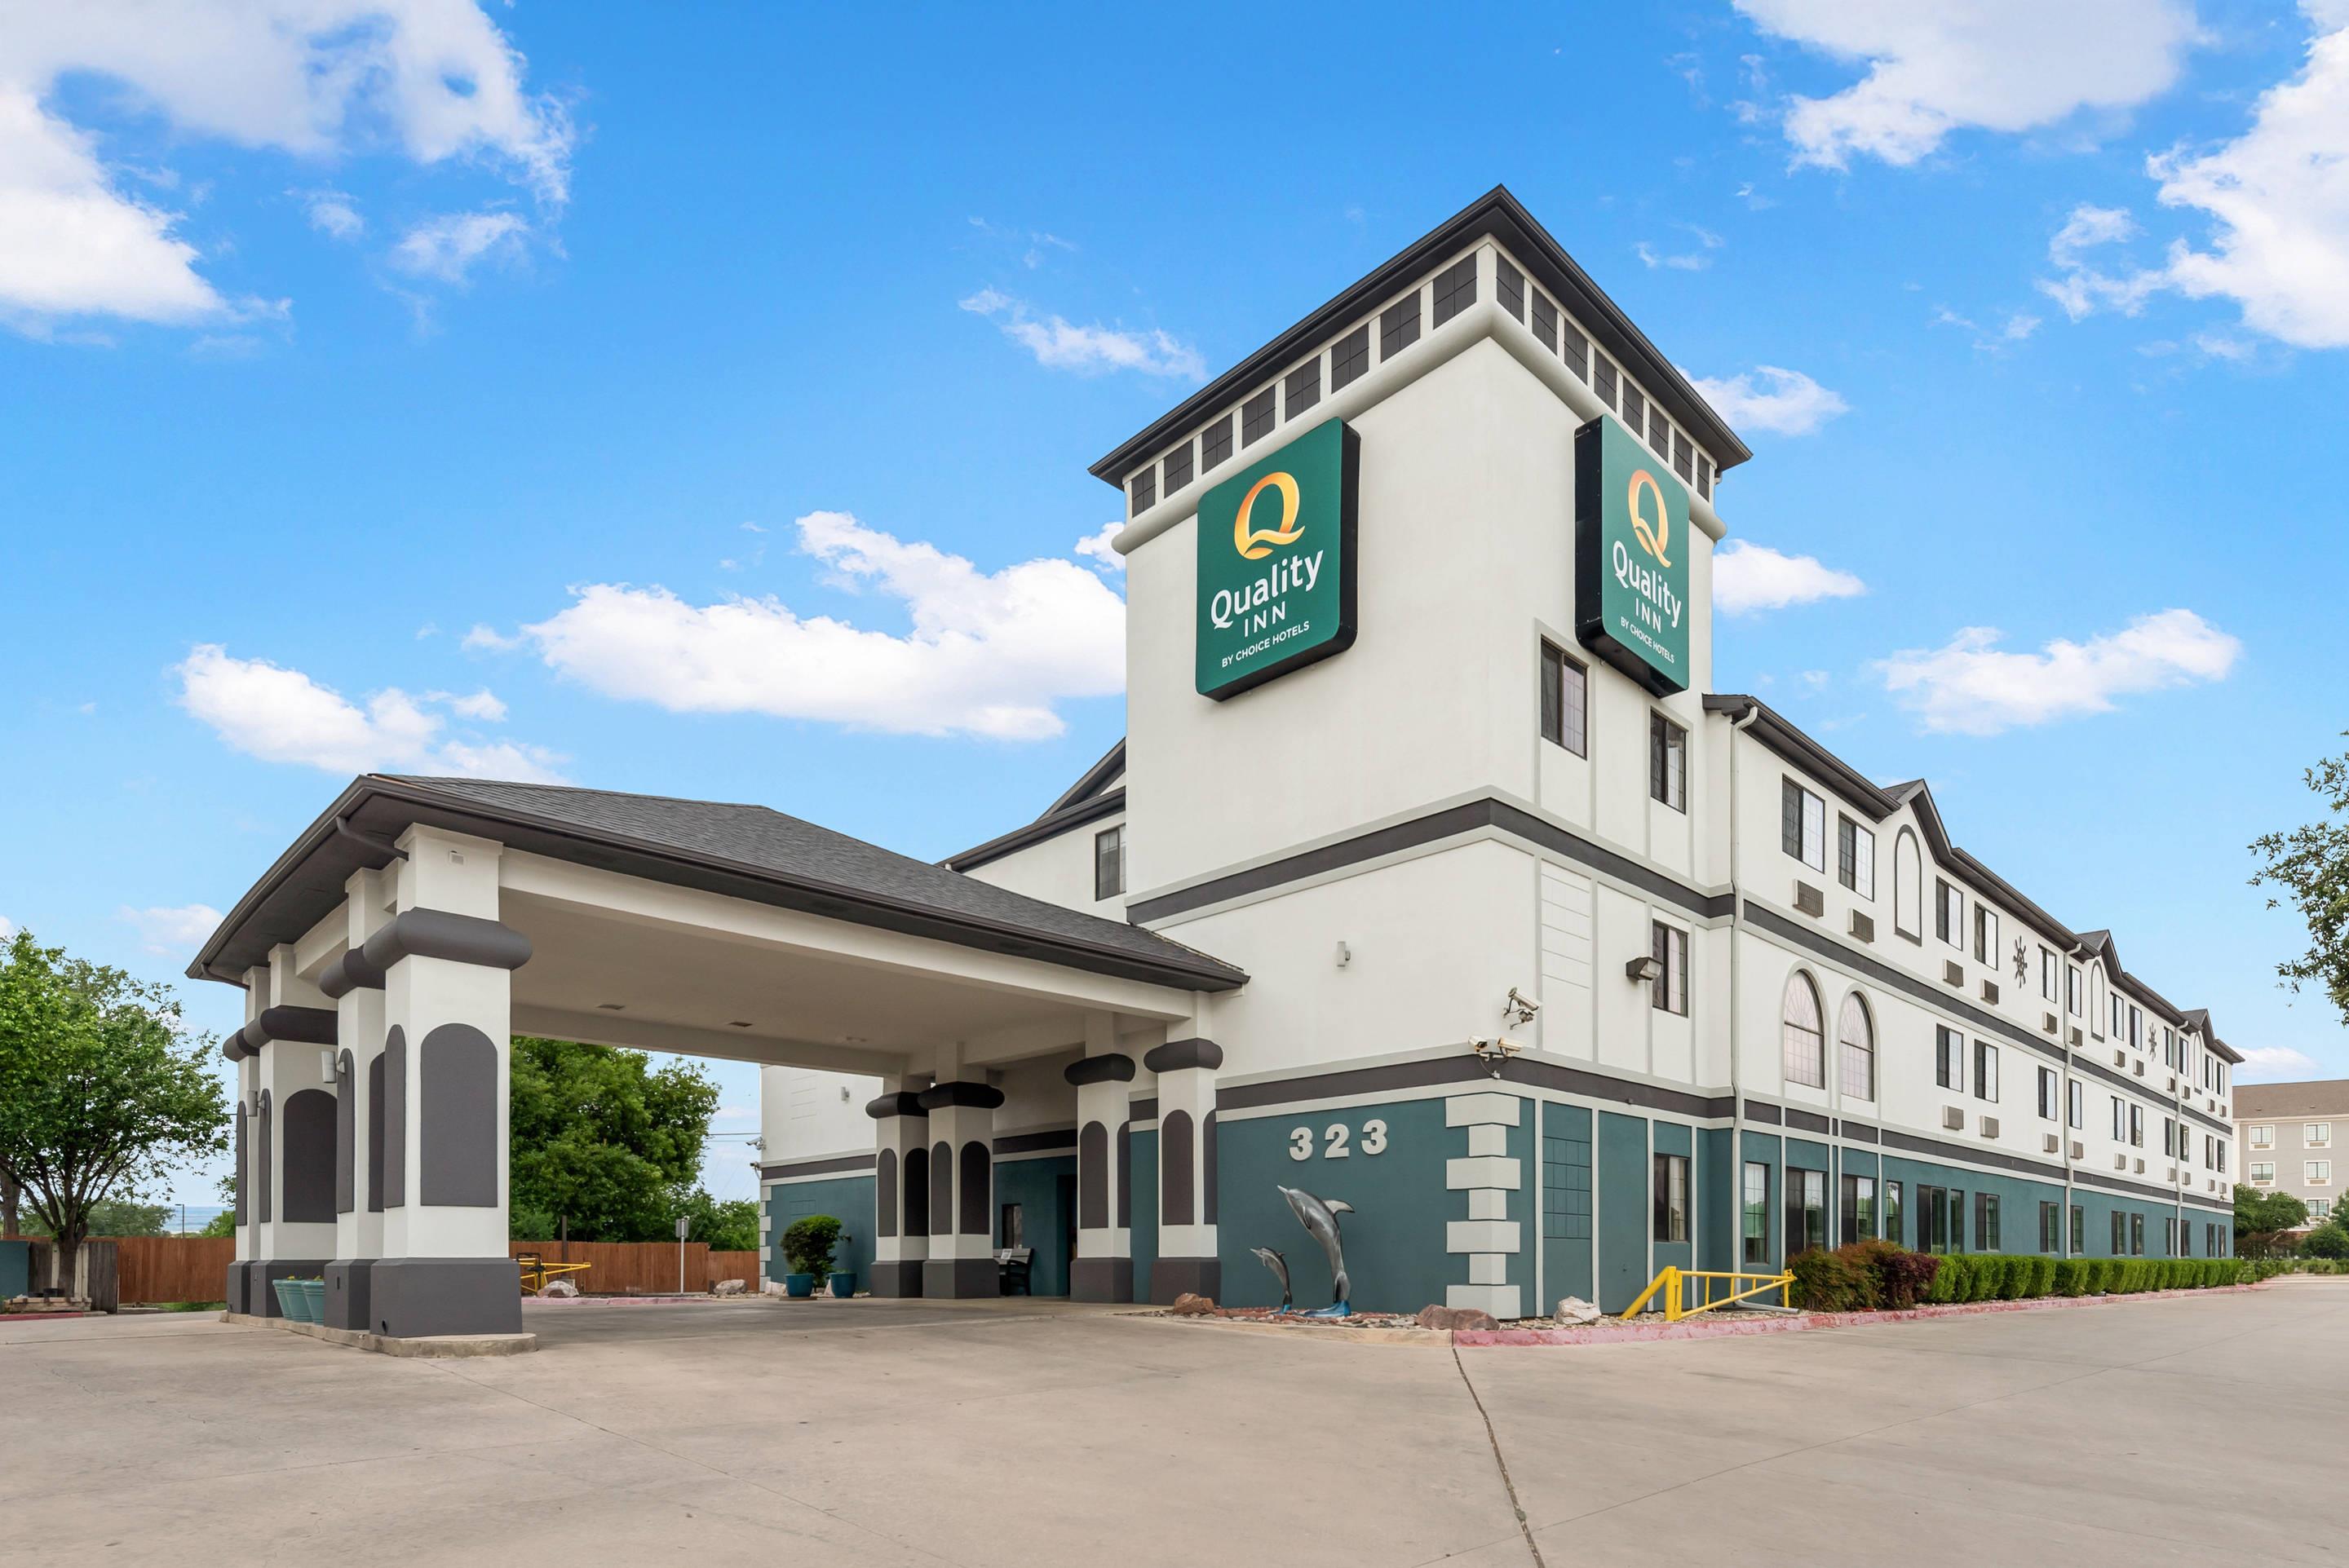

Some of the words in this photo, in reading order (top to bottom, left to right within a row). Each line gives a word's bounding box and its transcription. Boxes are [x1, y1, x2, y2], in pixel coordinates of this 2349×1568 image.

[1210, 550, 1324, 629] Quality
[1612, 540, 1682, 628] Quality
[1244, 601, 1286, 638] INN
[1635, 598, 1661, 634] INN
[1222, 655, 1234, 668] BY
[1236, 638, 1271, 661] CHOICE
[1272, 621, 1310, 645] HOTELS
[1621, 616, 1630, 629] BY
[1630, 623, 1652, 648] CHOICE
[1652, 641, 1675, 664] HOTELS
[1289, 1119, 1387, 1161] 323
